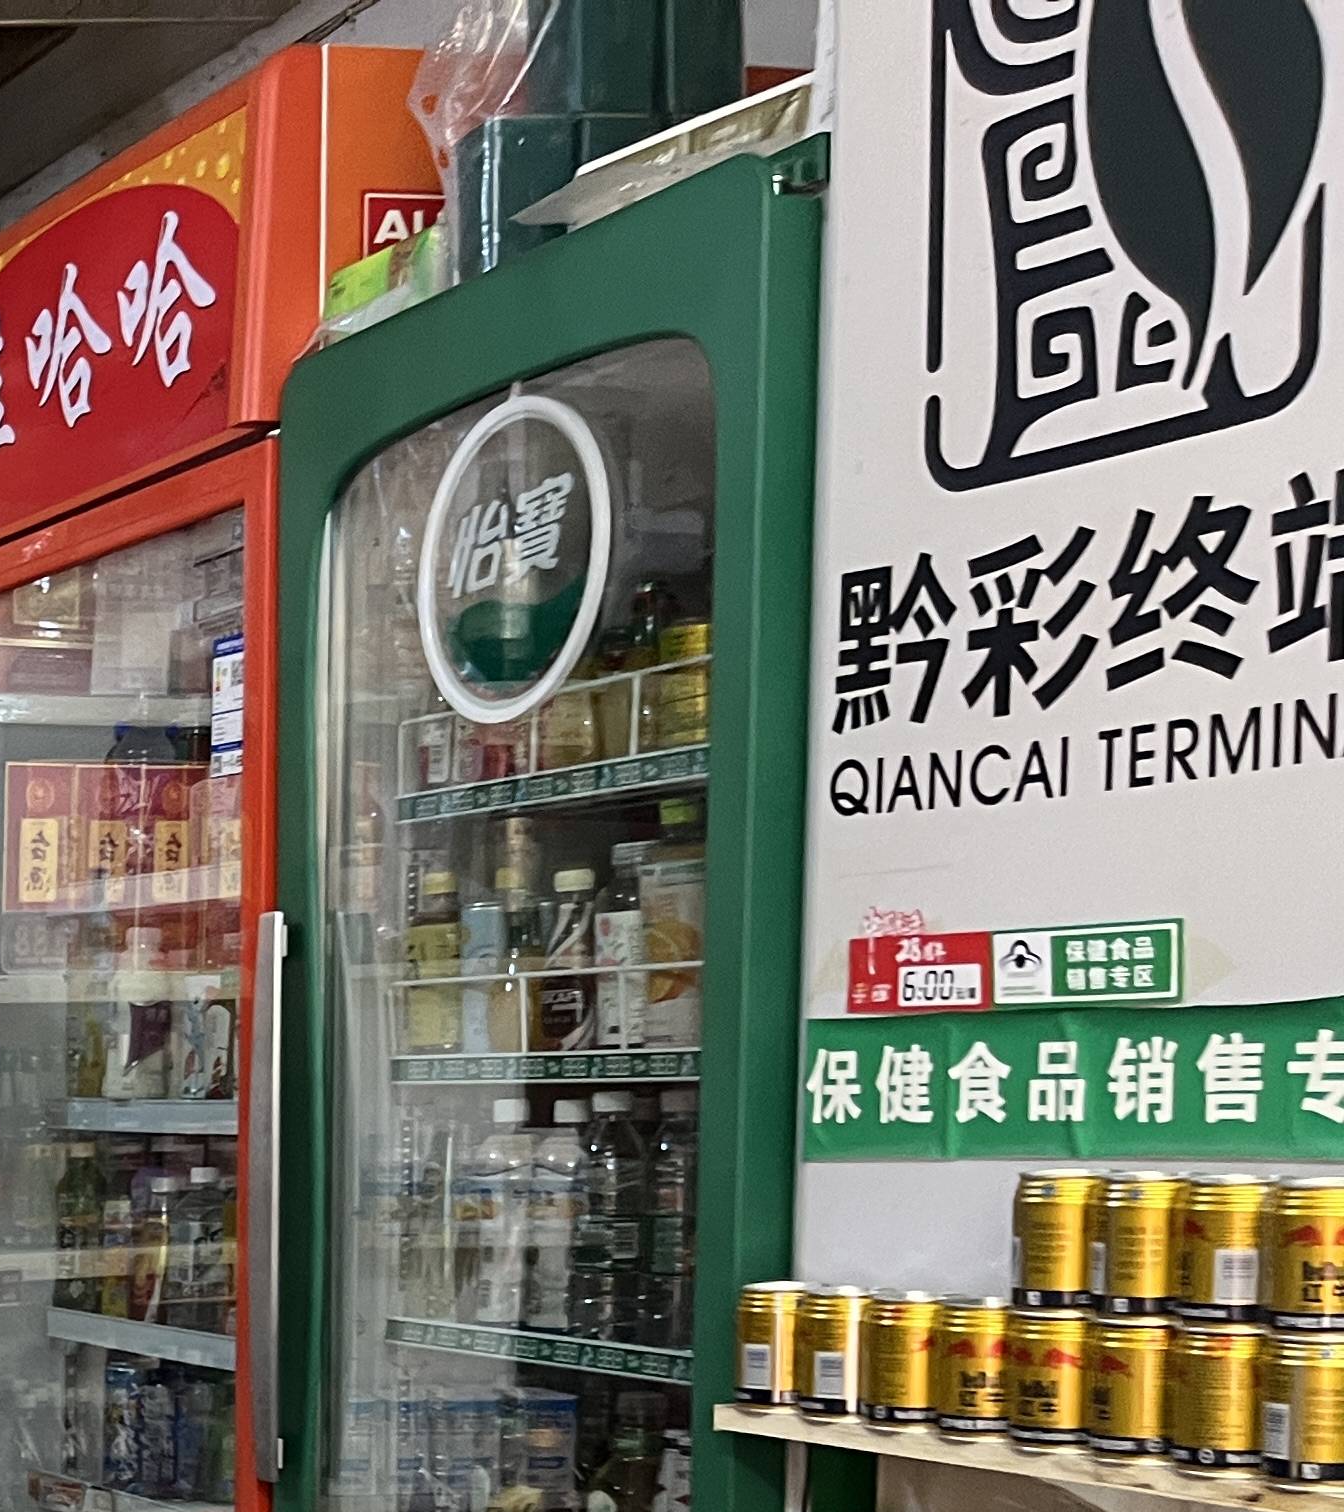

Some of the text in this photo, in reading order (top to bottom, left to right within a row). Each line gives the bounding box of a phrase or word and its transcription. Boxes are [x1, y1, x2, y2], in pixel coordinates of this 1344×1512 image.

[830, 693, 1344, 816] QIANCAI TERMIN
[806, 1029, 1344, 1124] 保健食品销售专
